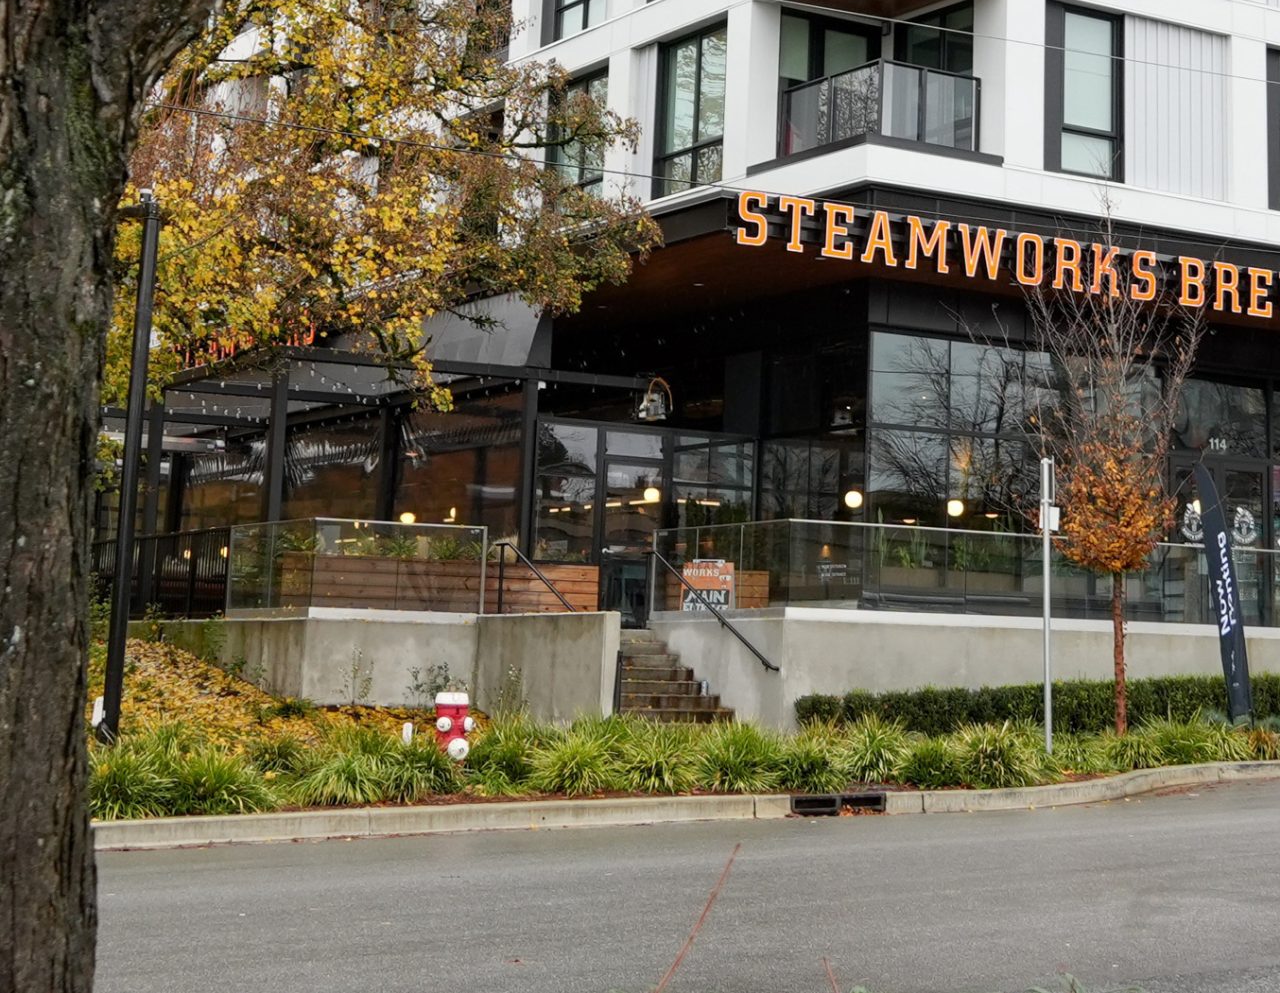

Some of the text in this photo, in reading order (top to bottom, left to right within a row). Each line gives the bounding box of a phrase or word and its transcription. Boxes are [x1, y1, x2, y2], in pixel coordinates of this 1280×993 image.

[736, 190, 1157, 301] STEAMWORKS
[1208, 437, 1227, 450] 114
[683, 568, 720, 577] WORKS
[1216, 580, 1231, 636] Now
